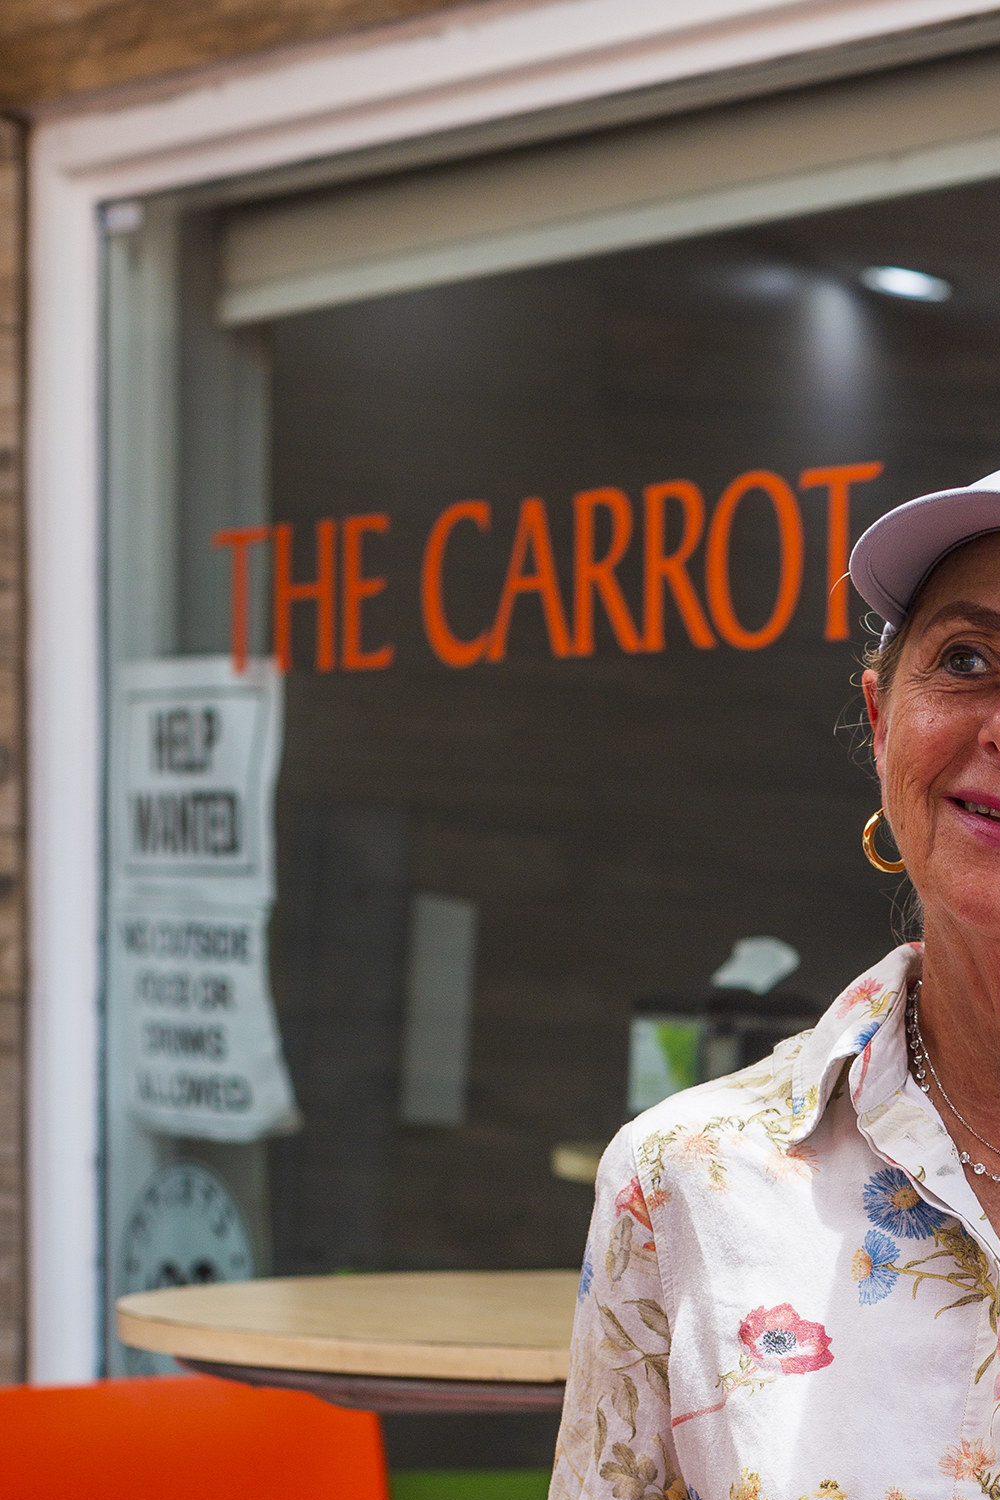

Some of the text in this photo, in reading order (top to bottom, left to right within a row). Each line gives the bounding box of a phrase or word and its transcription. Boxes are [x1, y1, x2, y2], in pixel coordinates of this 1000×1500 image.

[212, 461, 883, 675] THE CARROT
[152, 706, 220, 773] HELP
[130, 789, 240, 855] WANTED
